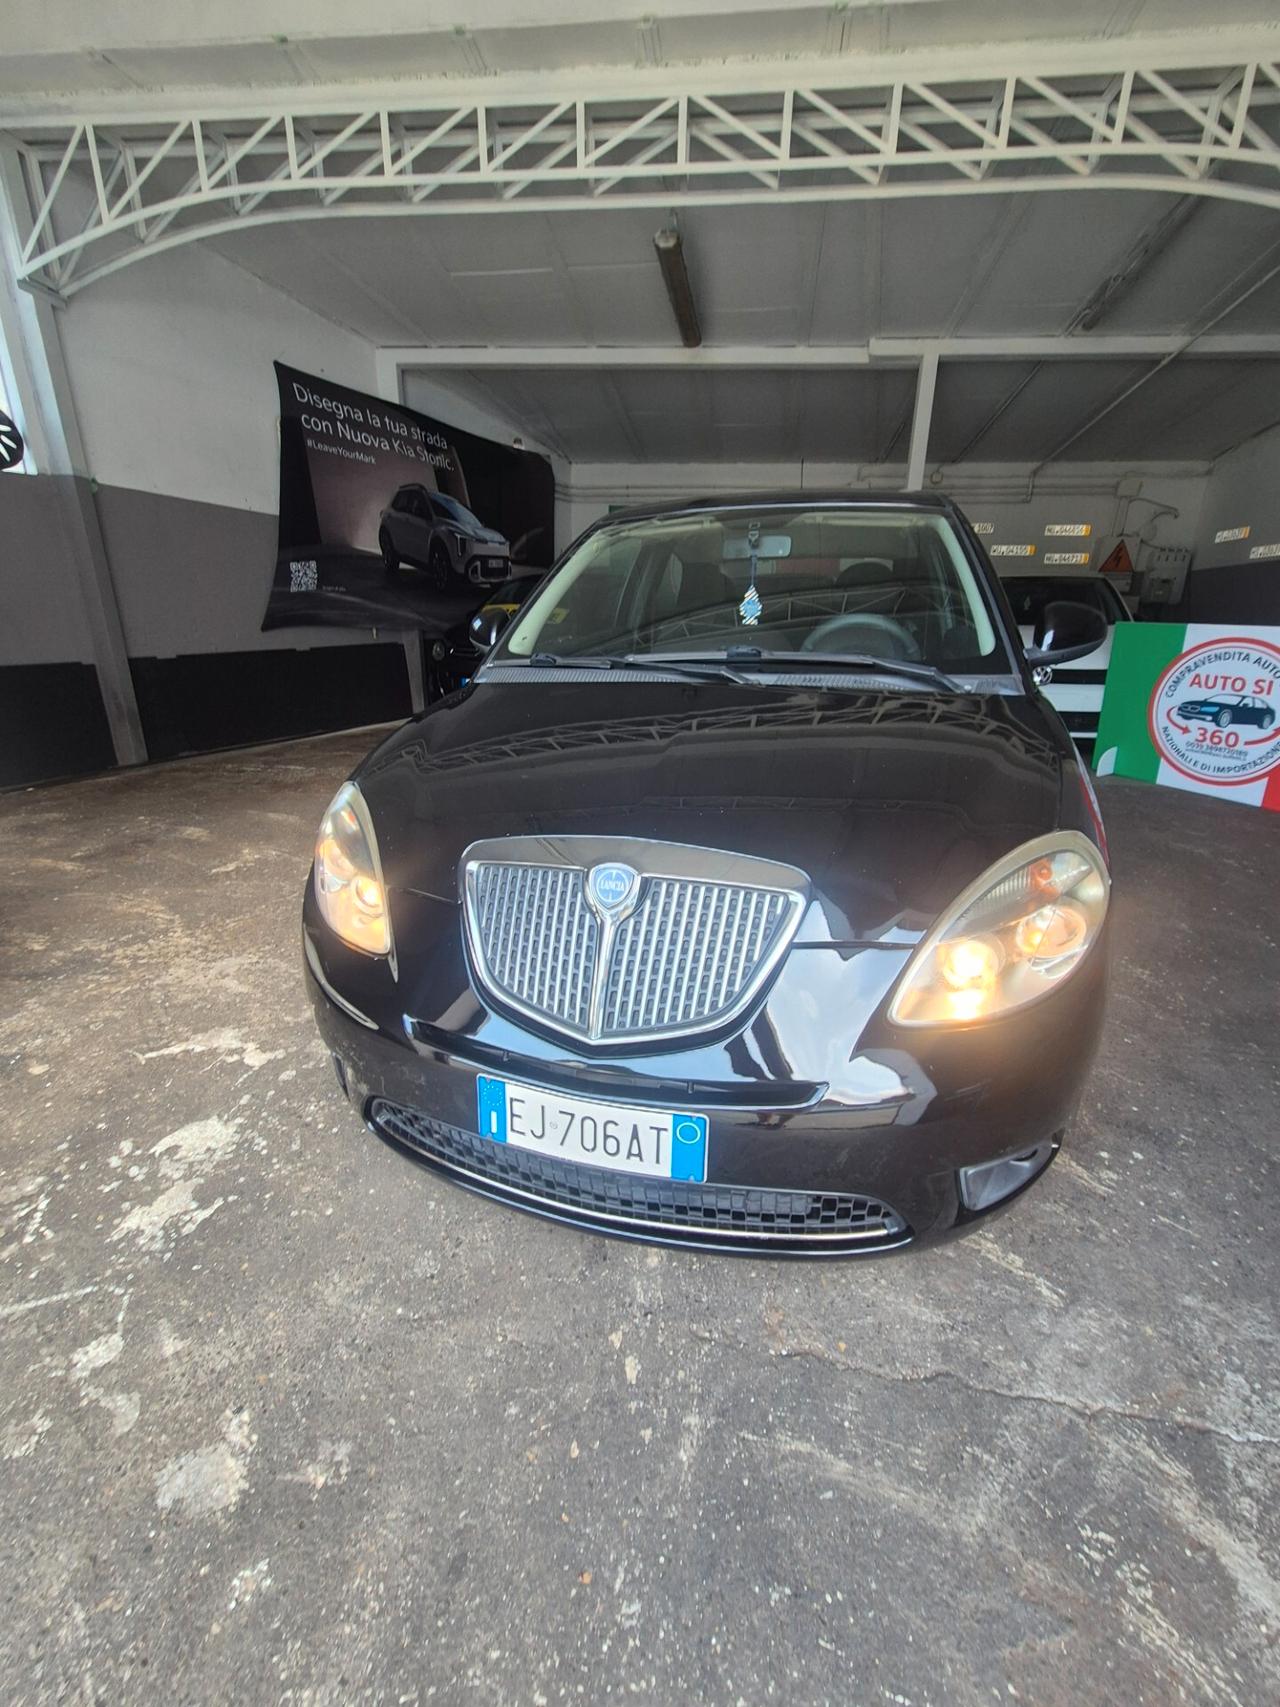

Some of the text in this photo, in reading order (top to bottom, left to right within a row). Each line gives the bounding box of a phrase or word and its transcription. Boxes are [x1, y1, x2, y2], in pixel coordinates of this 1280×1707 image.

[292, 382, 448, 449] Disegna la tua strada
[301, 414, 455, 471] con Nuova Kia Stonic.
[307, 439, 377, 465] #LeaveYourMark
[1165, 650, 1251, 698] COMPRAVENDITA
[1189, 673, 1274, 696] AUTO SI
[1161, 726, 1193, 766] NAZIONALI
[1200, 764, 1210, 772] DI
[1195, 726, 1240, 748] 360
